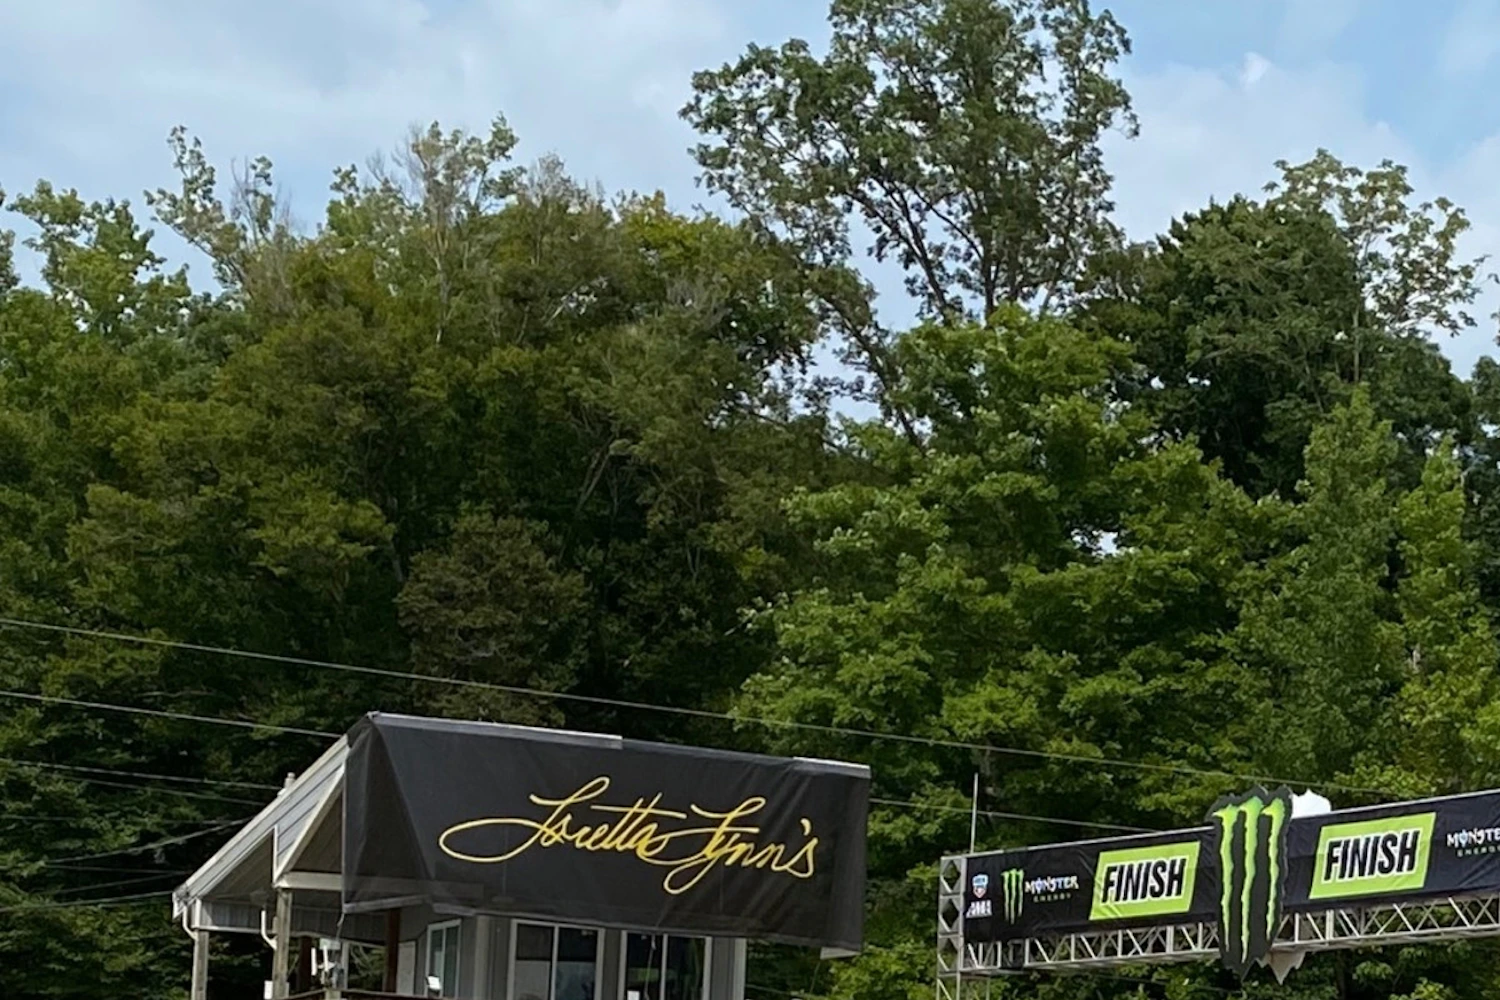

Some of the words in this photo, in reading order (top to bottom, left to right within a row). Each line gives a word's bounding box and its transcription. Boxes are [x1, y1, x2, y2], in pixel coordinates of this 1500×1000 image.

[439, 776, 686, 862] Loretta
[638, 796, 817, 895] Lynn's
[1323, 829, 1420, 881] FINISH
[1025, 875, 1079, 895] MONSTER
[1101, 857, 1187, 903] FINISH
